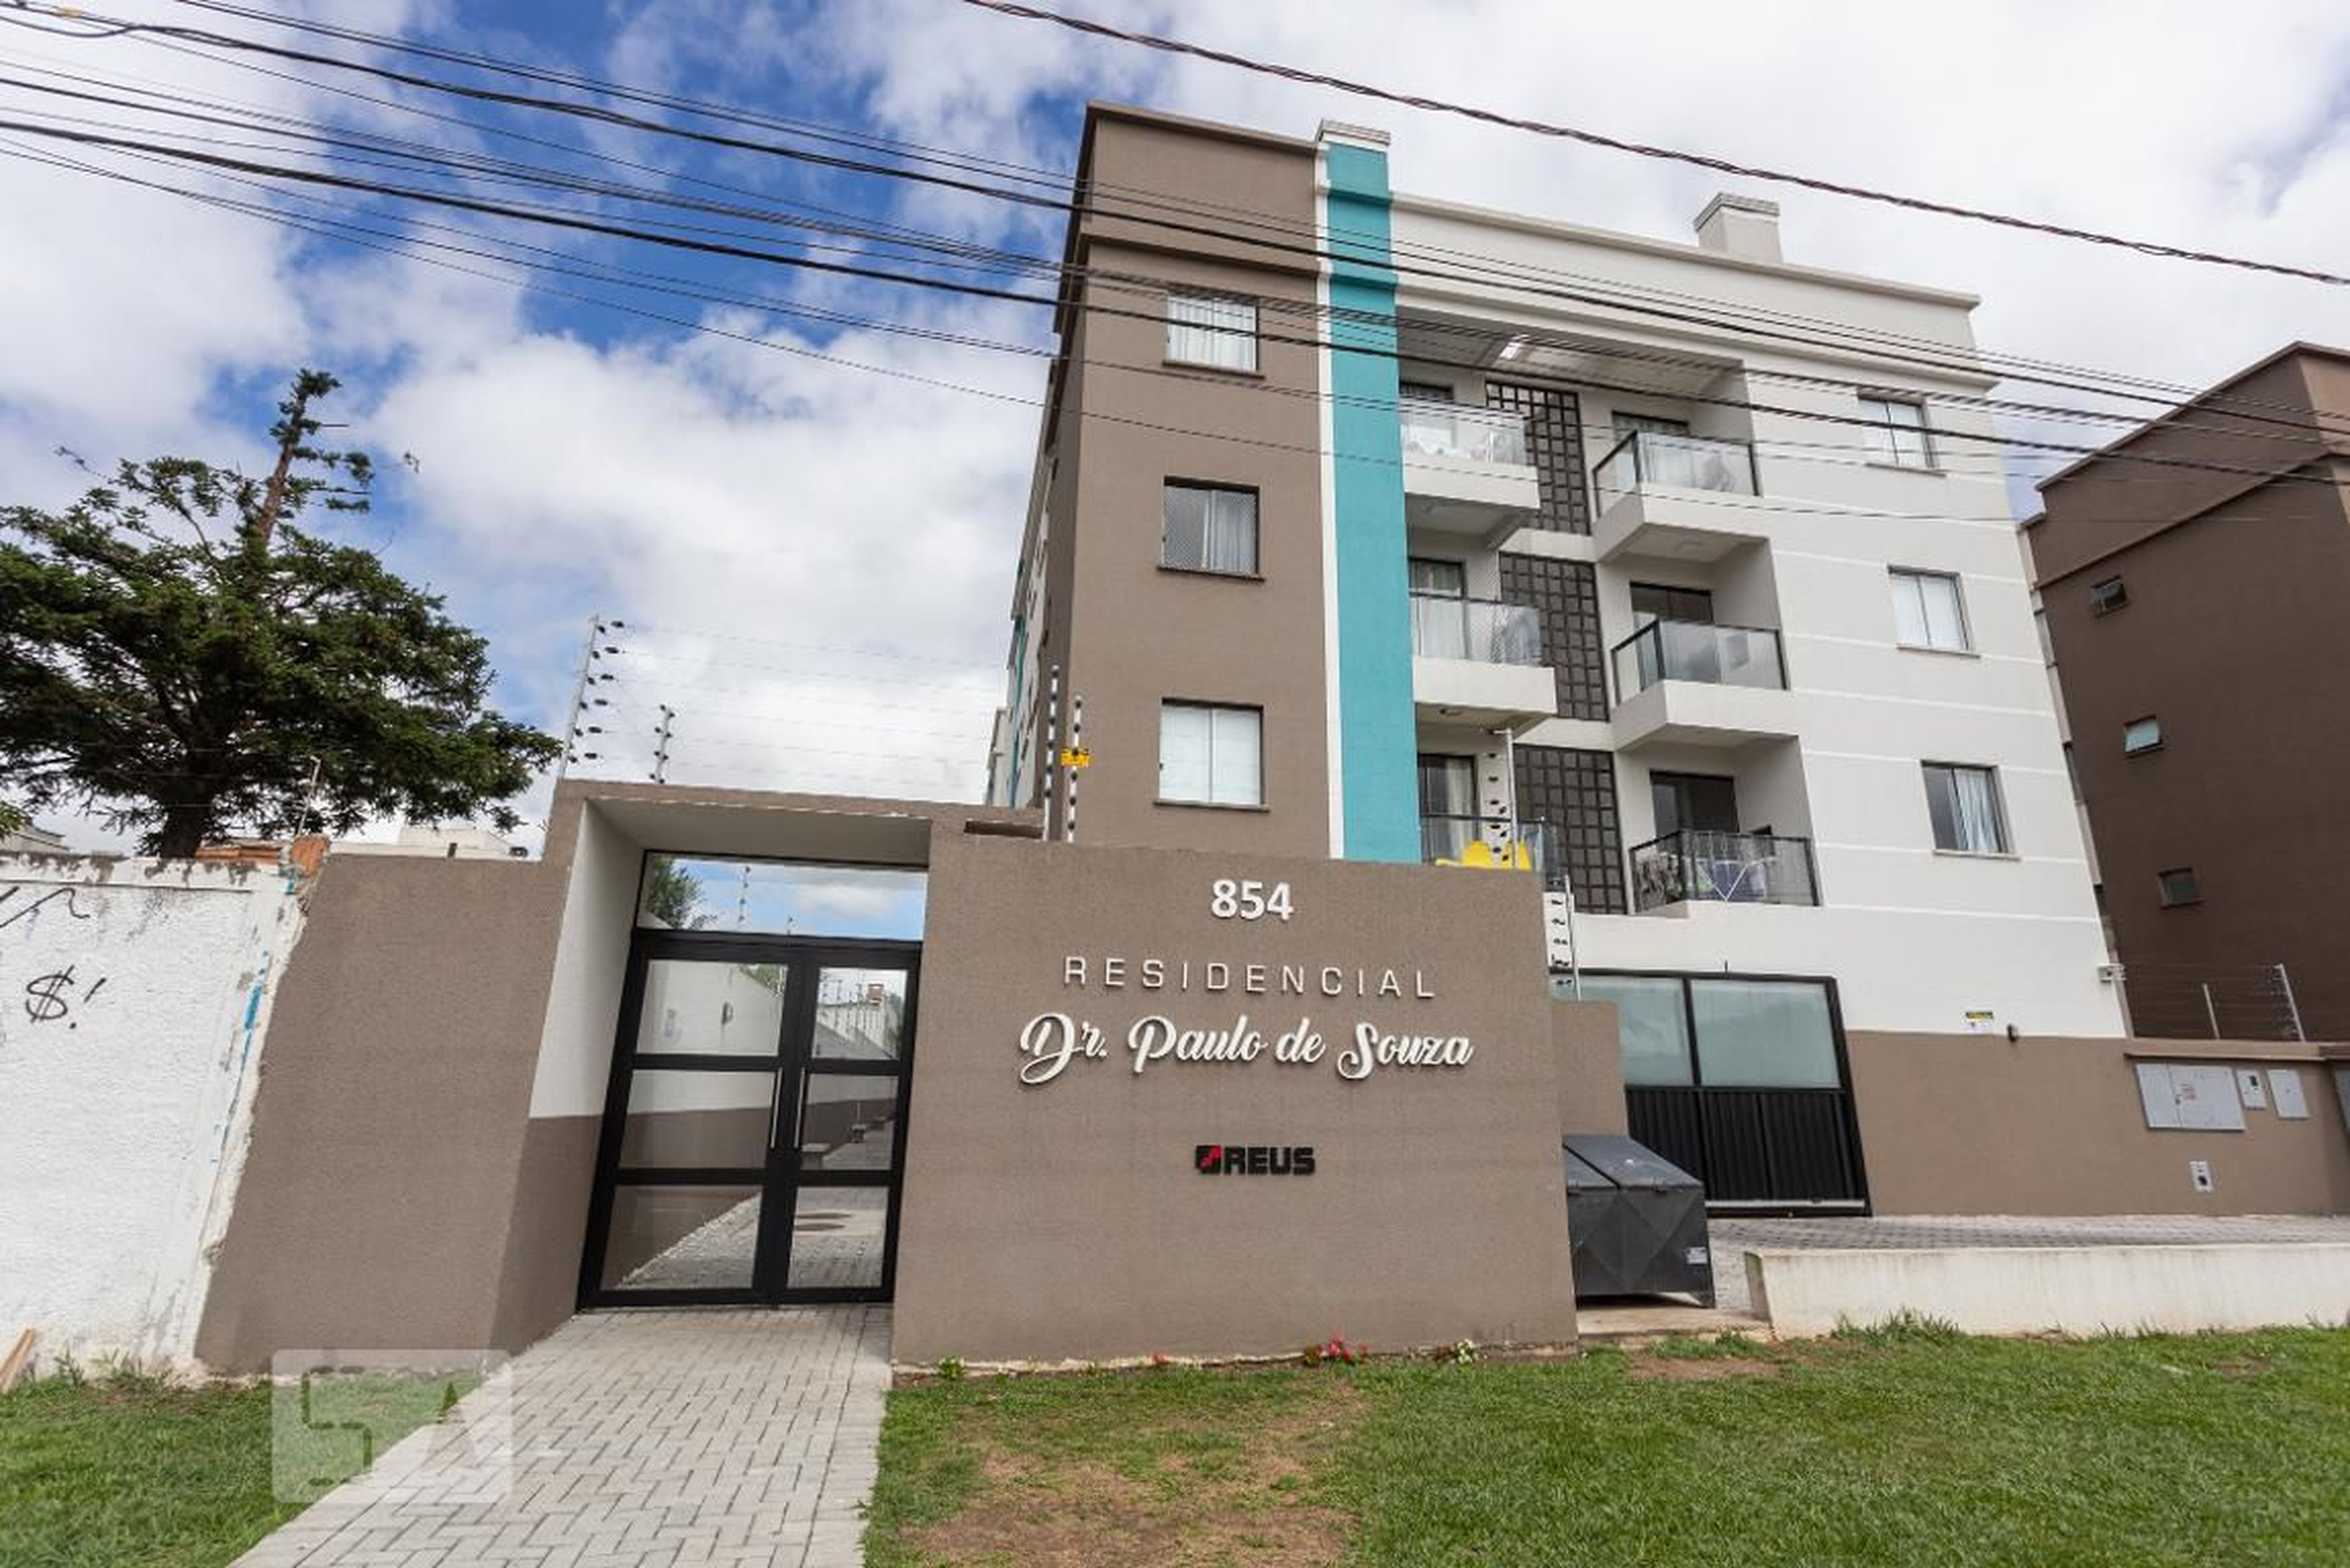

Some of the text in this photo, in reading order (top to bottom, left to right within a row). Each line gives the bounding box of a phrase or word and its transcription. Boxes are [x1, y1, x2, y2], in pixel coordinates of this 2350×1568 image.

[1210, 879, 1294, 921] 854
[1064, 955, 1434, 998] RESIDENCIAL
[1019, 1012, 1474, 1084] Dr. Paulo de Souza
[1223, 1146, 1316, 1176] REUS
